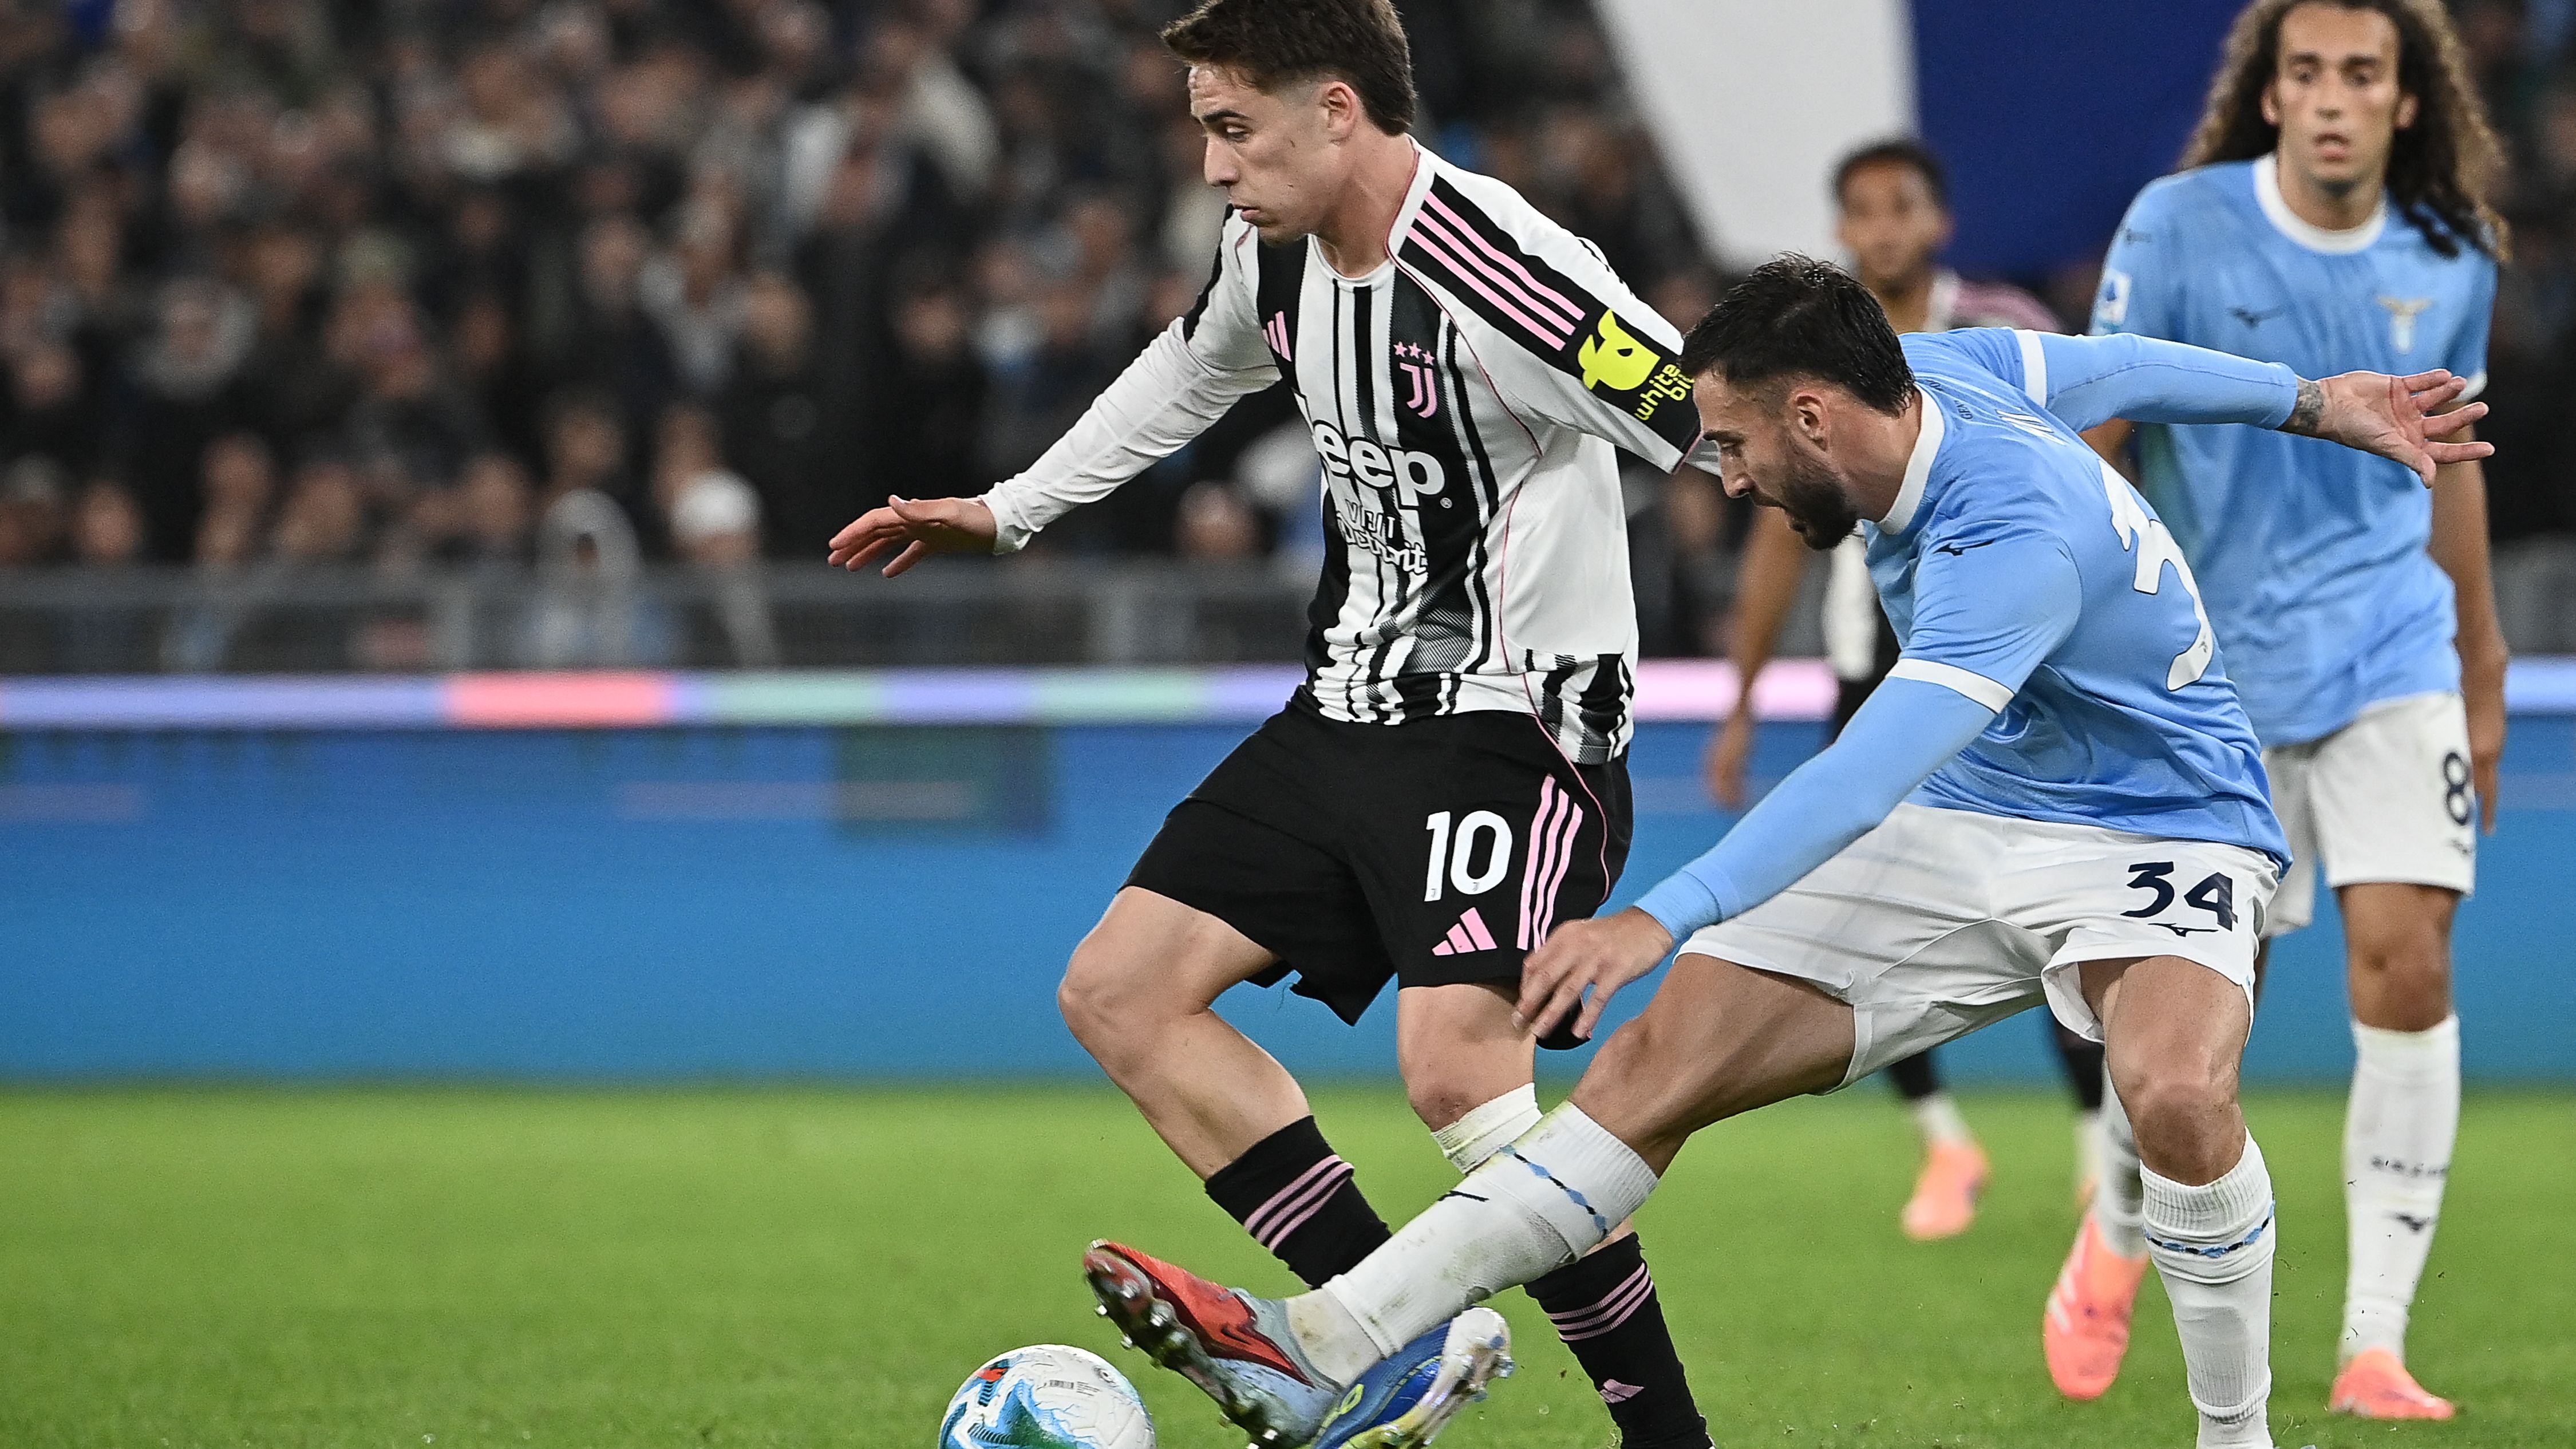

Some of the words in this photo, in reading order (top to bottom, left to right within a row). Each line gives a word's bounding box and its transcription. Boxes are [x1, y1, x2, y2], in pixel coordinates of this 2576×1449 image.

[1634, 364, 1681, 420] white
[1294, 393, 1445, 506] eep
[2443, 752, 2470, 826] 8
[1424, 810, 1512, 901] 10
[2120, 862, 2238, 931] 34
